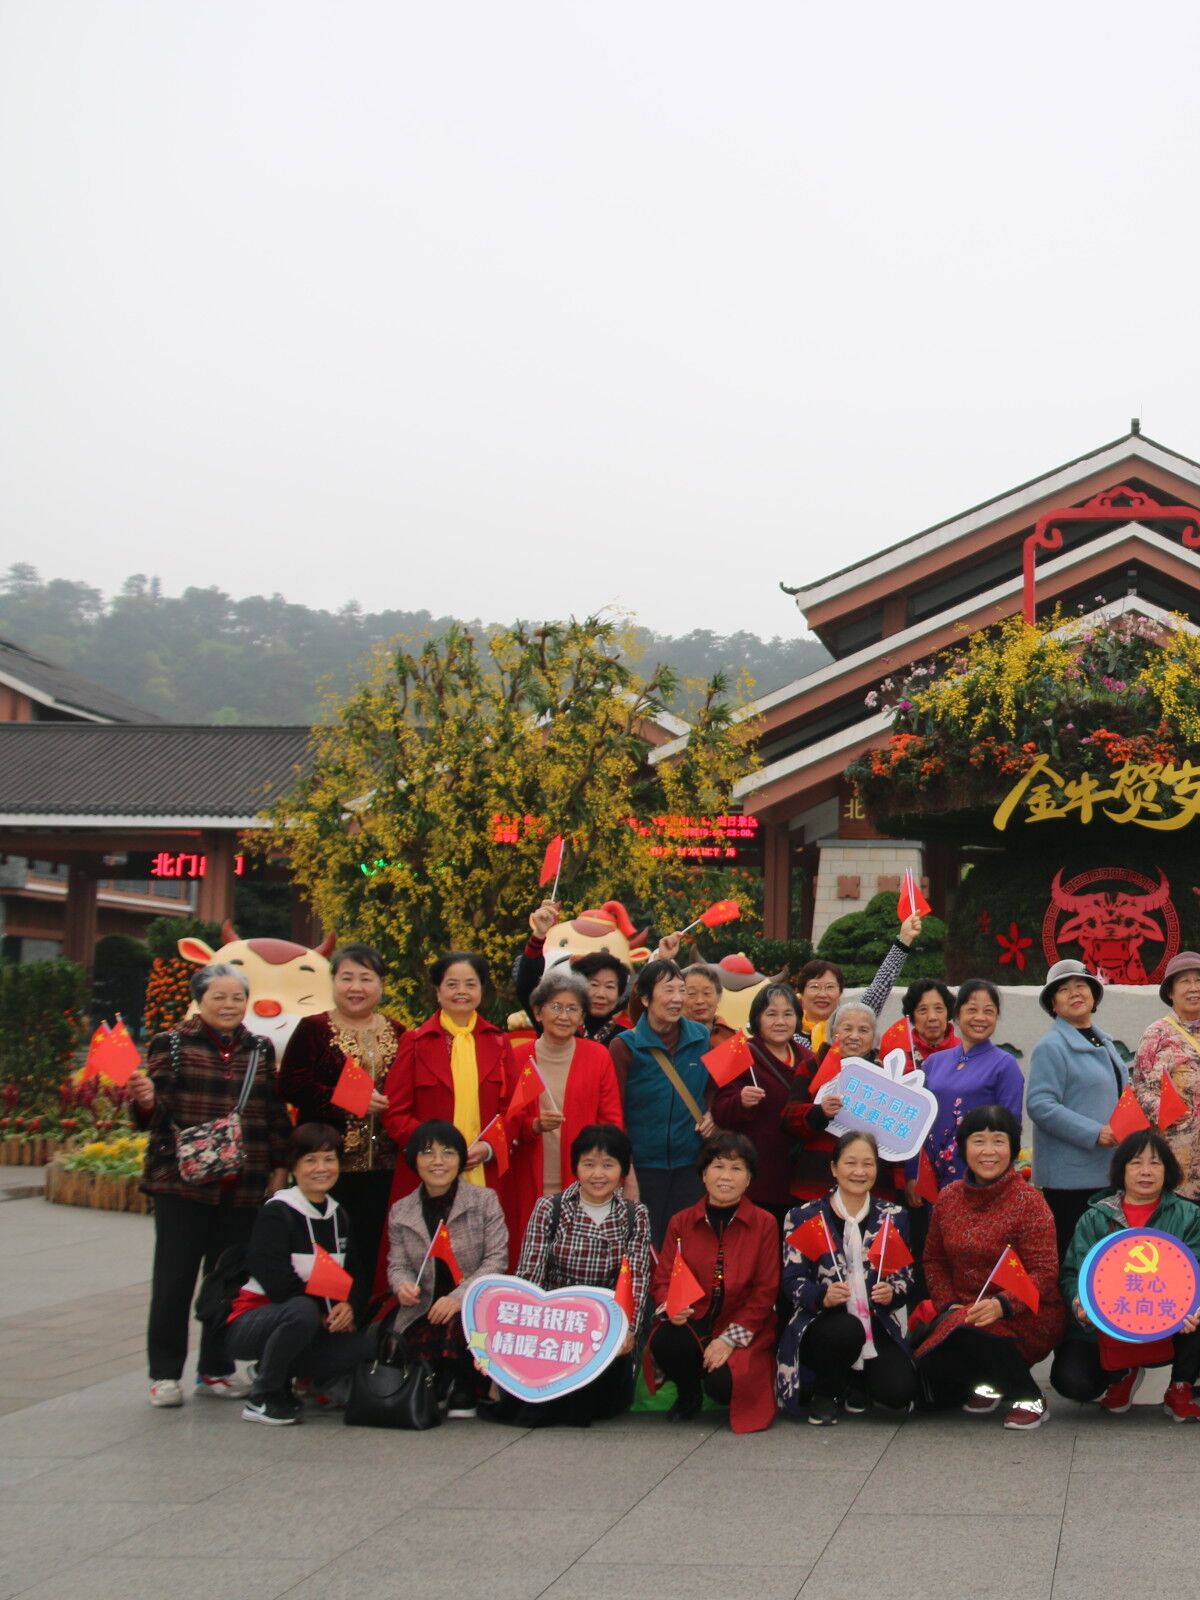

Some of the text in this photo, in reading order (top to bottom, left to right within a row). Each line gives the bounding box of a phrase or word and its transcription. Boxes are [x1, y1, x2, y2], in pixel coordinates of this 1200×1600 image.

[1125, 1274, 1166, 1294] 我心
[496, 1300, 589, 1334] 爱聚银辉
[1113, 1296, 1177, 1320] 永向党
[491, 1331, 584, 1364] 情暖金秋
